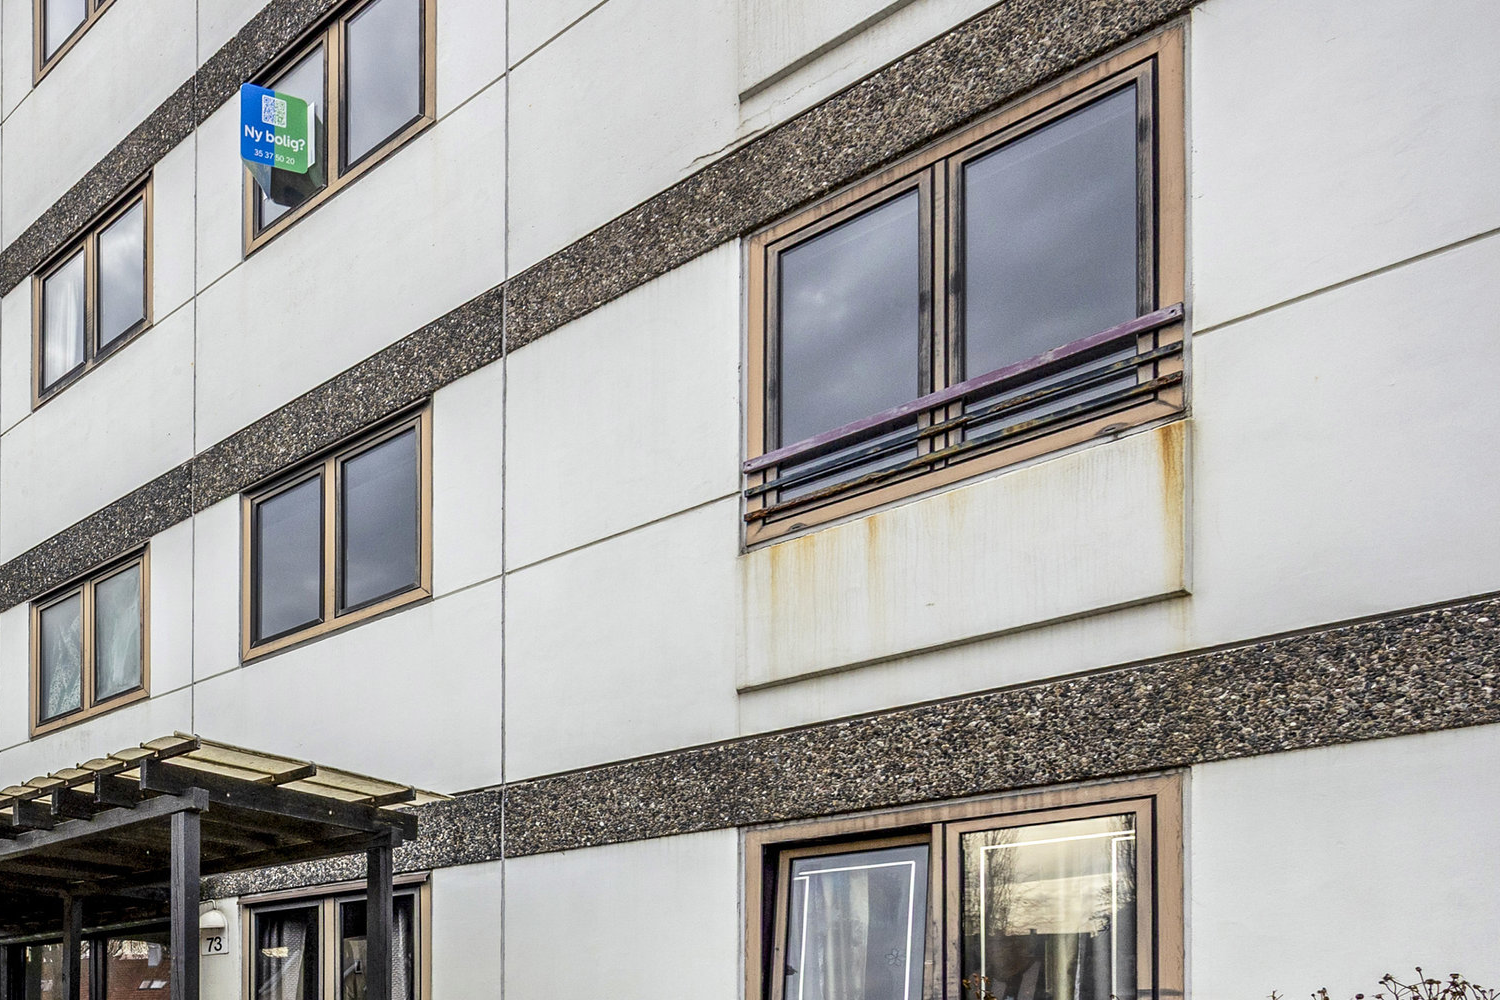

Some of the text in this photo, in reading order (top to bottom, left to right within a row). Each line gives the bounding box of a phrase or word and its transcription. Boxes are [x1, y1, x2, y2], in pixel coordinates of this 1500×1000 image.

[244, 125, 306, 152] Ny bolig?
[254, 149, 263, 157] 35
[265, 151, 274, 159] 37
[286, 157, 295, 165] 20
[206, 936, 222, 952] 73
